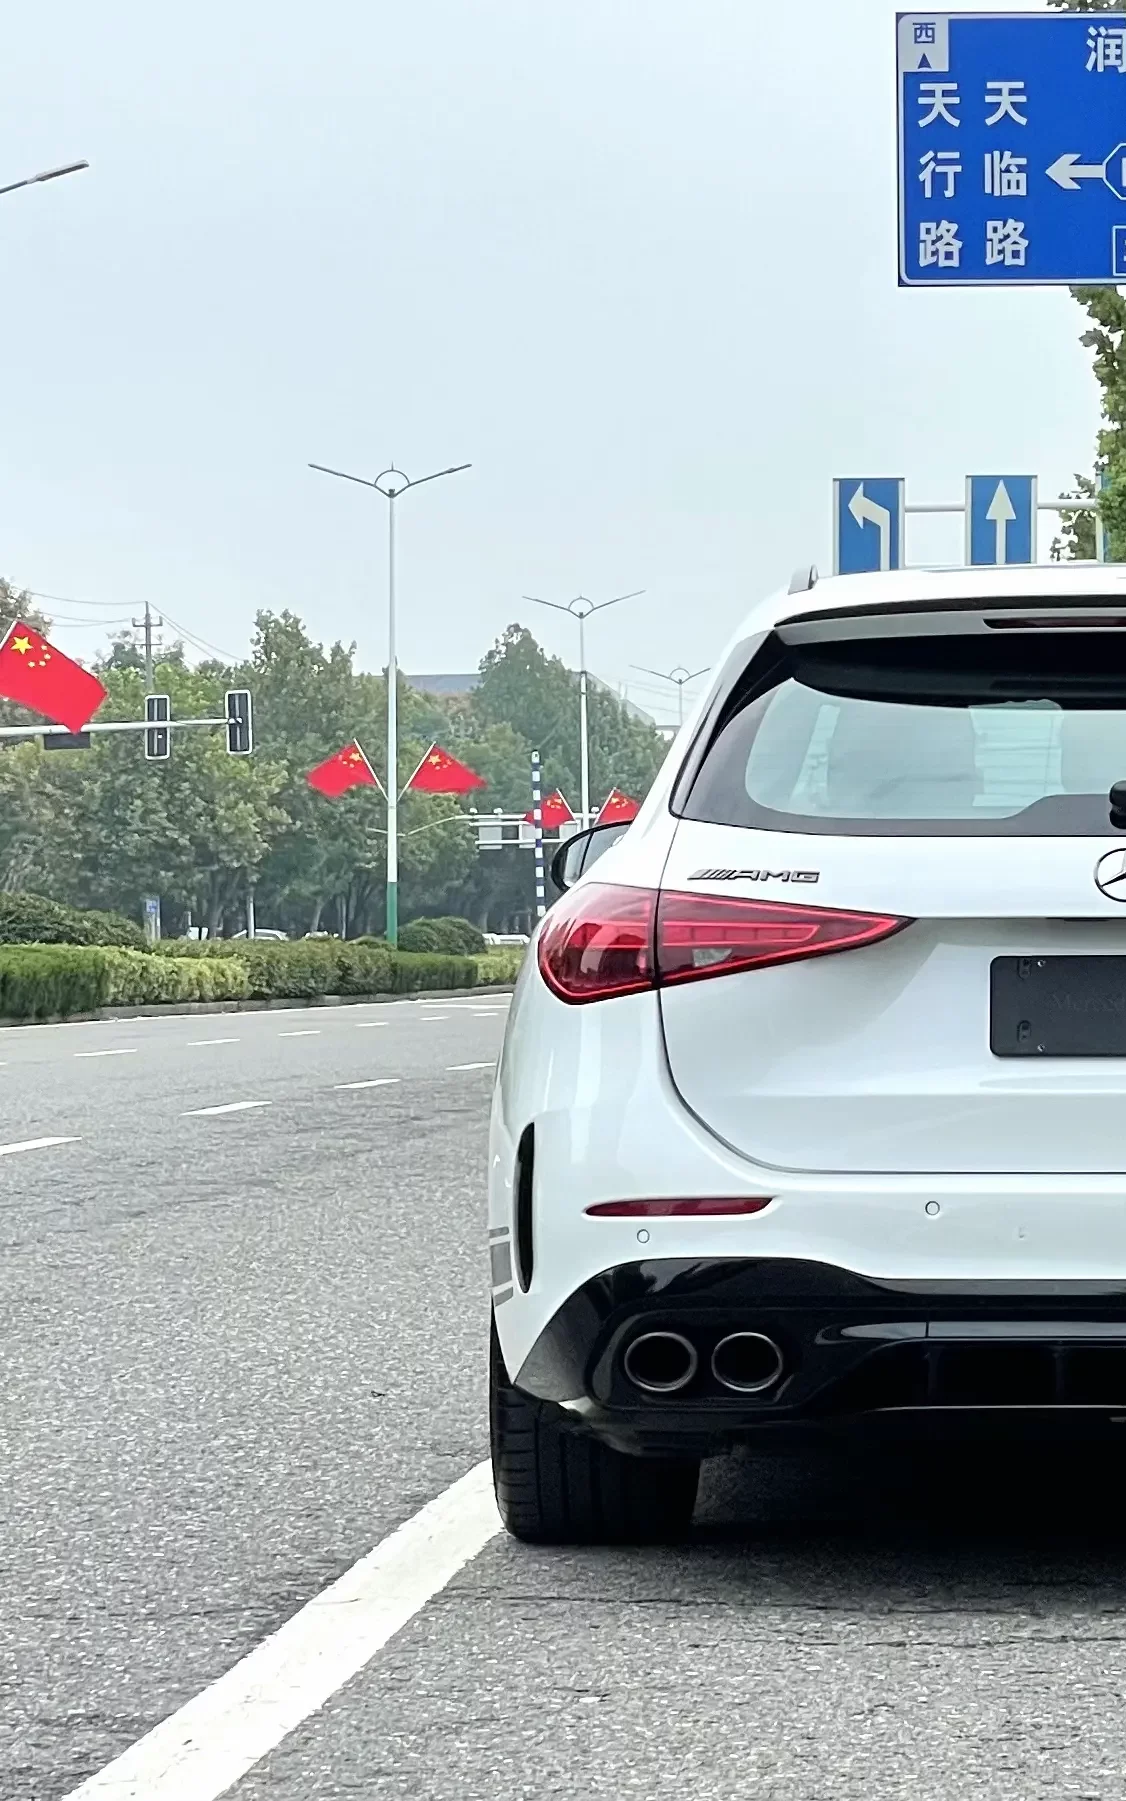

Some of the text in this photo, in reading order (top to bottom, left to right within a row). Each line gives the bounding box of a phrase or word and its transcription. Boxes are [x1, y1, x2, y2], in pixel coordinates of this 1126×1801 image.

[912, 22, 936, 44] 西
[917, 82, 963, 268] 天行路
[984, 81, 1029, 267] 天临路
[725, 869, 820, 883] AMG
